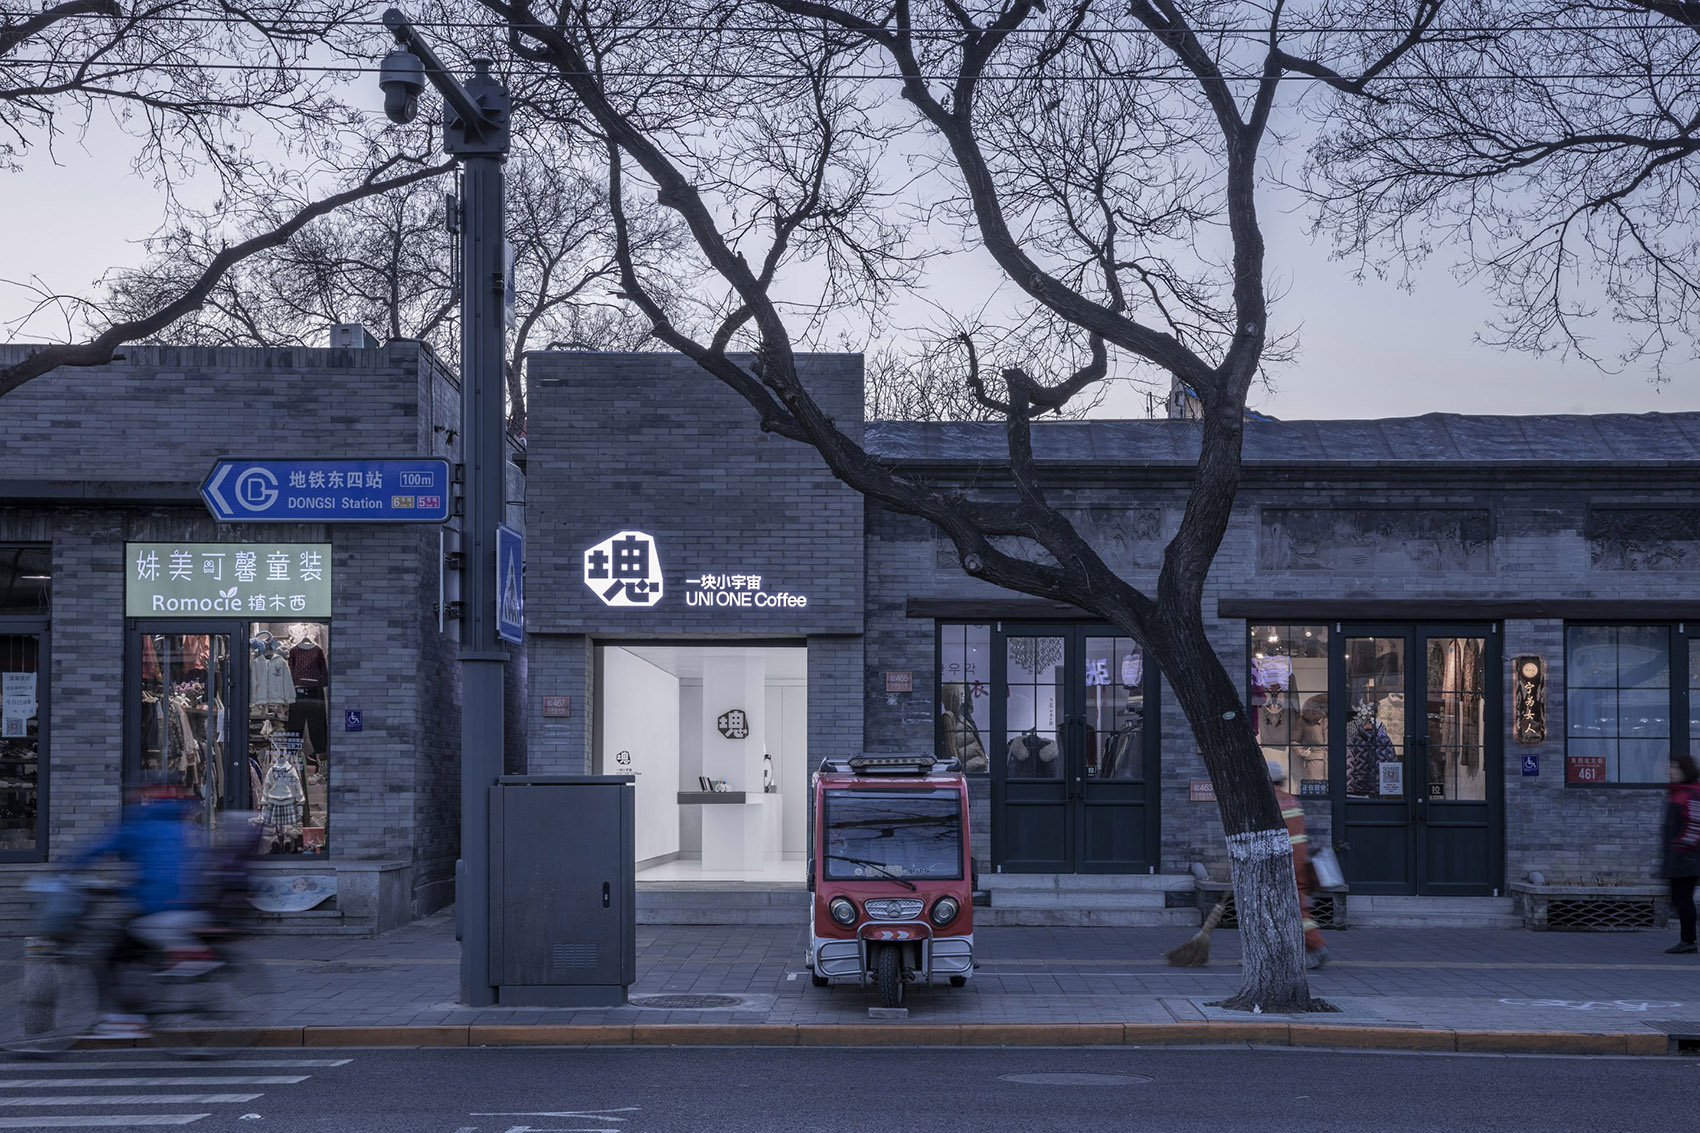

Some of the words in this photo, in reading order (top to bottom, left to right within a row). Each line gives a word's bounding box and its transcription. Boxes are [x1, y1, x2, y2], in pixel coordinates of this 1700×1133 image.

[289, 470, 383, 489] 地铁东四站
[402, 473, 432, 486] 100m
[288, 497, 336, 509] DONGSI
[341, 497, 383, 509] Station
[685, 574, 762, 591] 一块小宇宙
[248, 594, 306, 611] 植木西
[755, 591, 807, 608] Coffee
[1523, 681, 1537, 734] 宁为女人
[1578, 767, 1596, 780] 461
